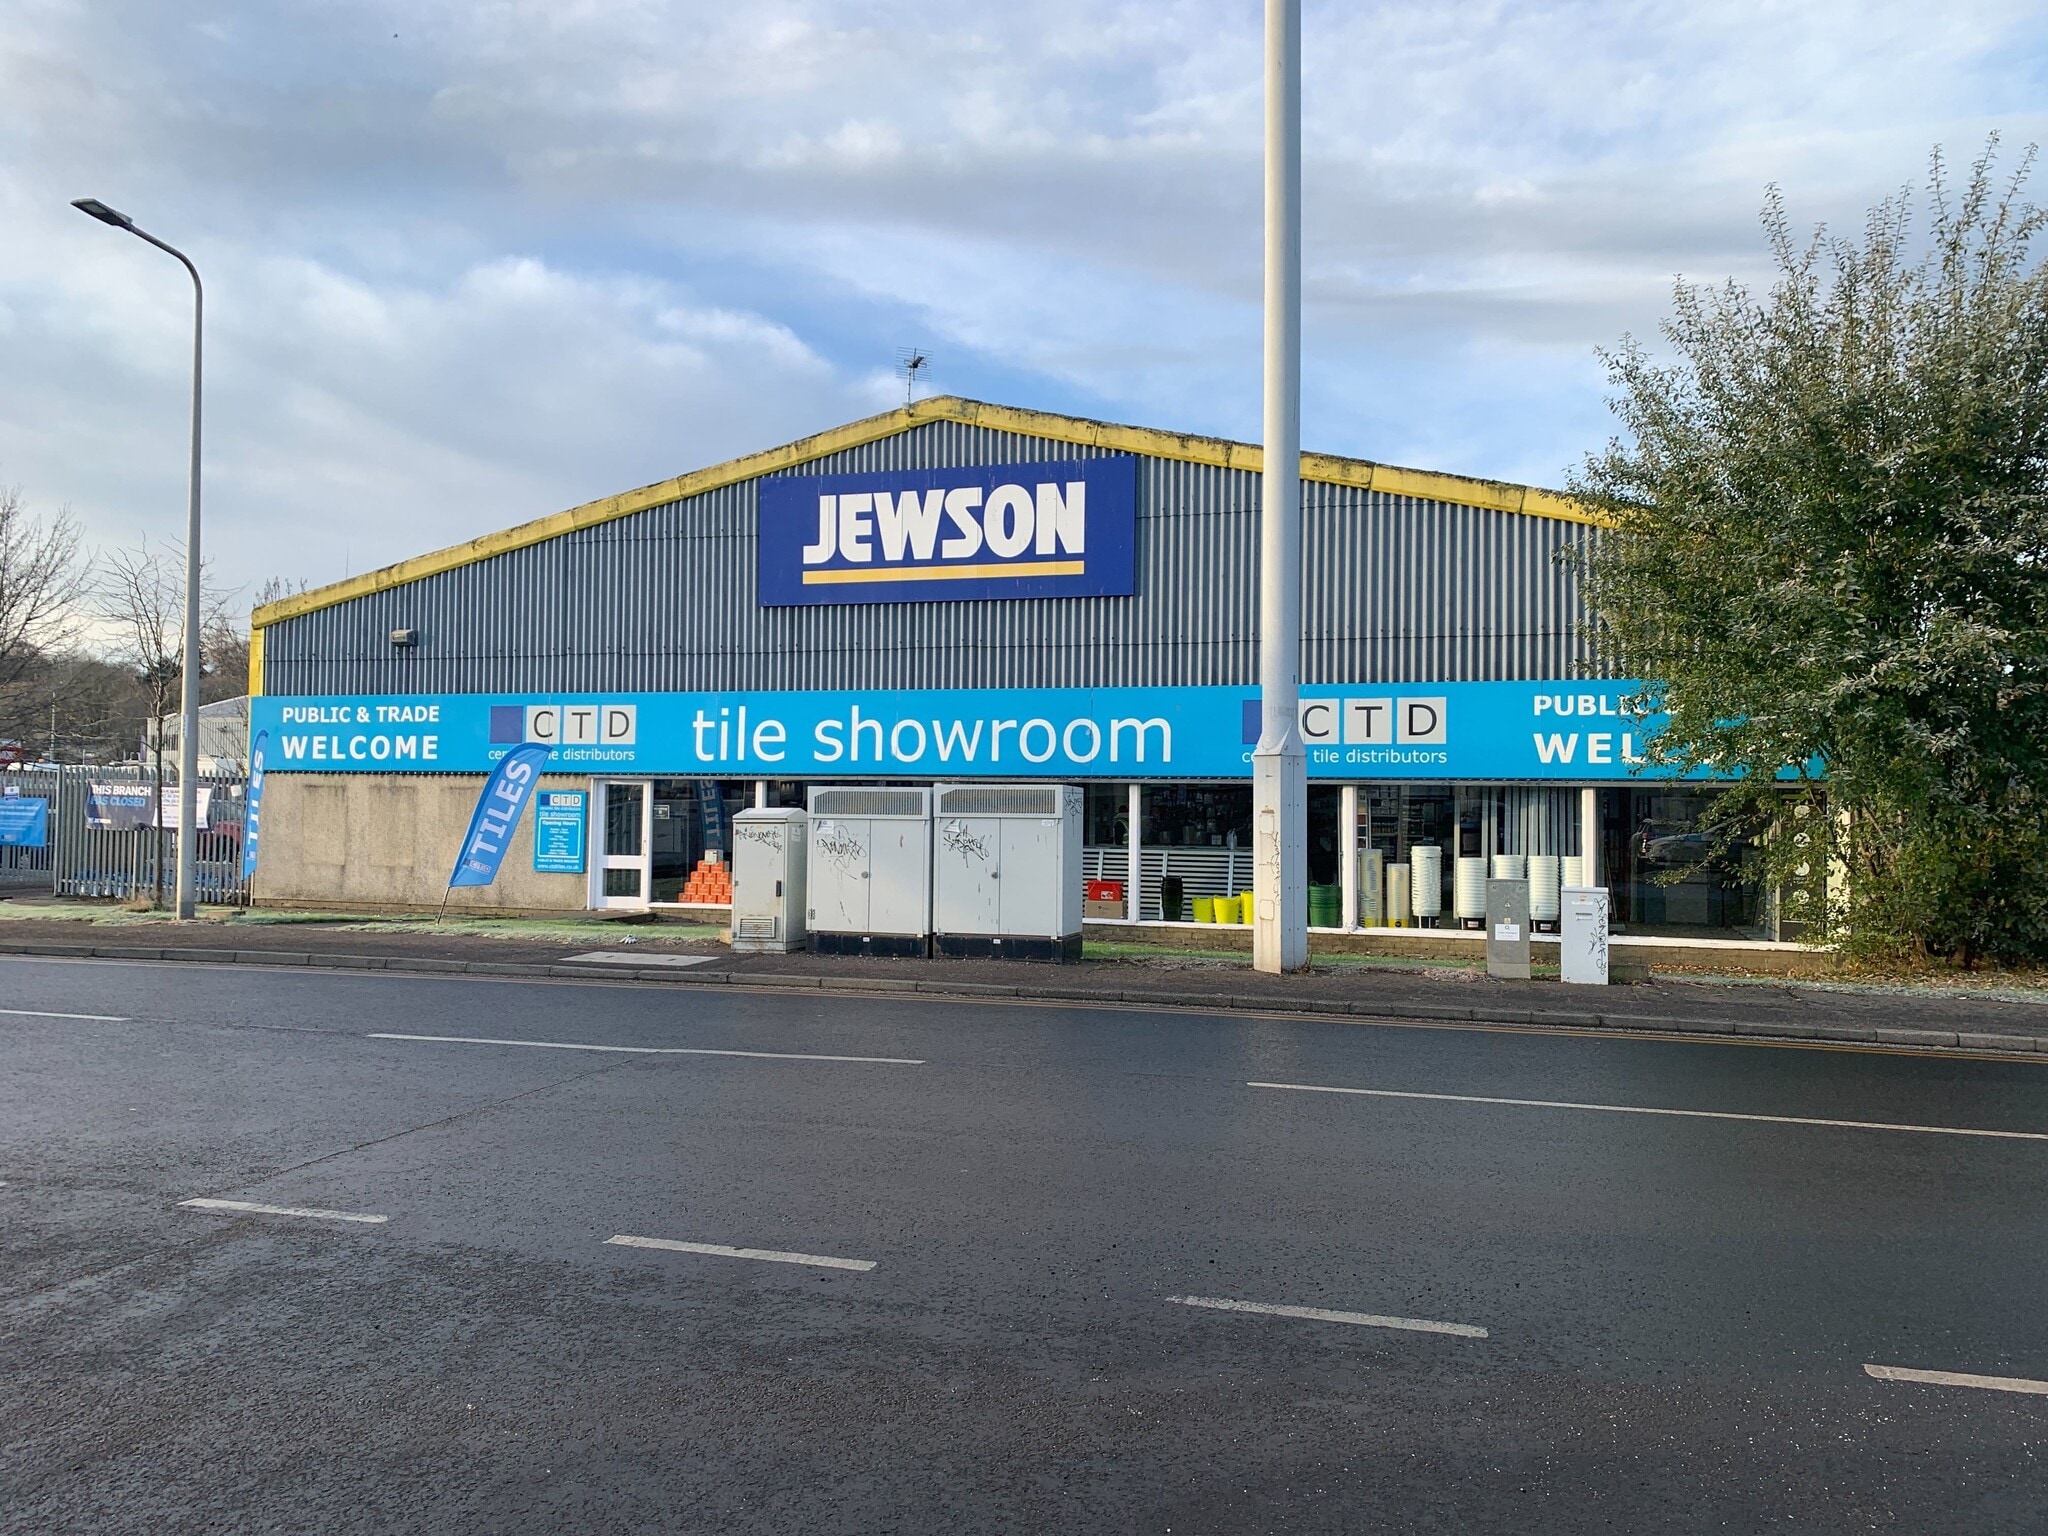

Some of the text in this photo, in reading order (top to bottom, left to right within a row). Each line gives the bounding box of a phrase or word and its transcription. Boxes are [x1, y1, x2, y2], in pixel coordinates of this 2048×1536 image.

[802, 481, 1086, 565] JEWSON
[282, 705, 440, 723] PUBLIC & TRADE
[533, 710, 630, 739] CTD
[1302, 703, 1438, 738] CTD
[693, 704, 1173, 763] tile showroom
[281, 735, 439, 760] WELCOME
[563, 748, 635, 761] distributors
[1313, 749, 1448, 764] tile distributors
[91, 784, 152, 797] THIS BRANCH
[552, 795, 581, 805] CTD
[109, 796, 146, 807] CLOSED
[470, 759, 532, 854] TILES
